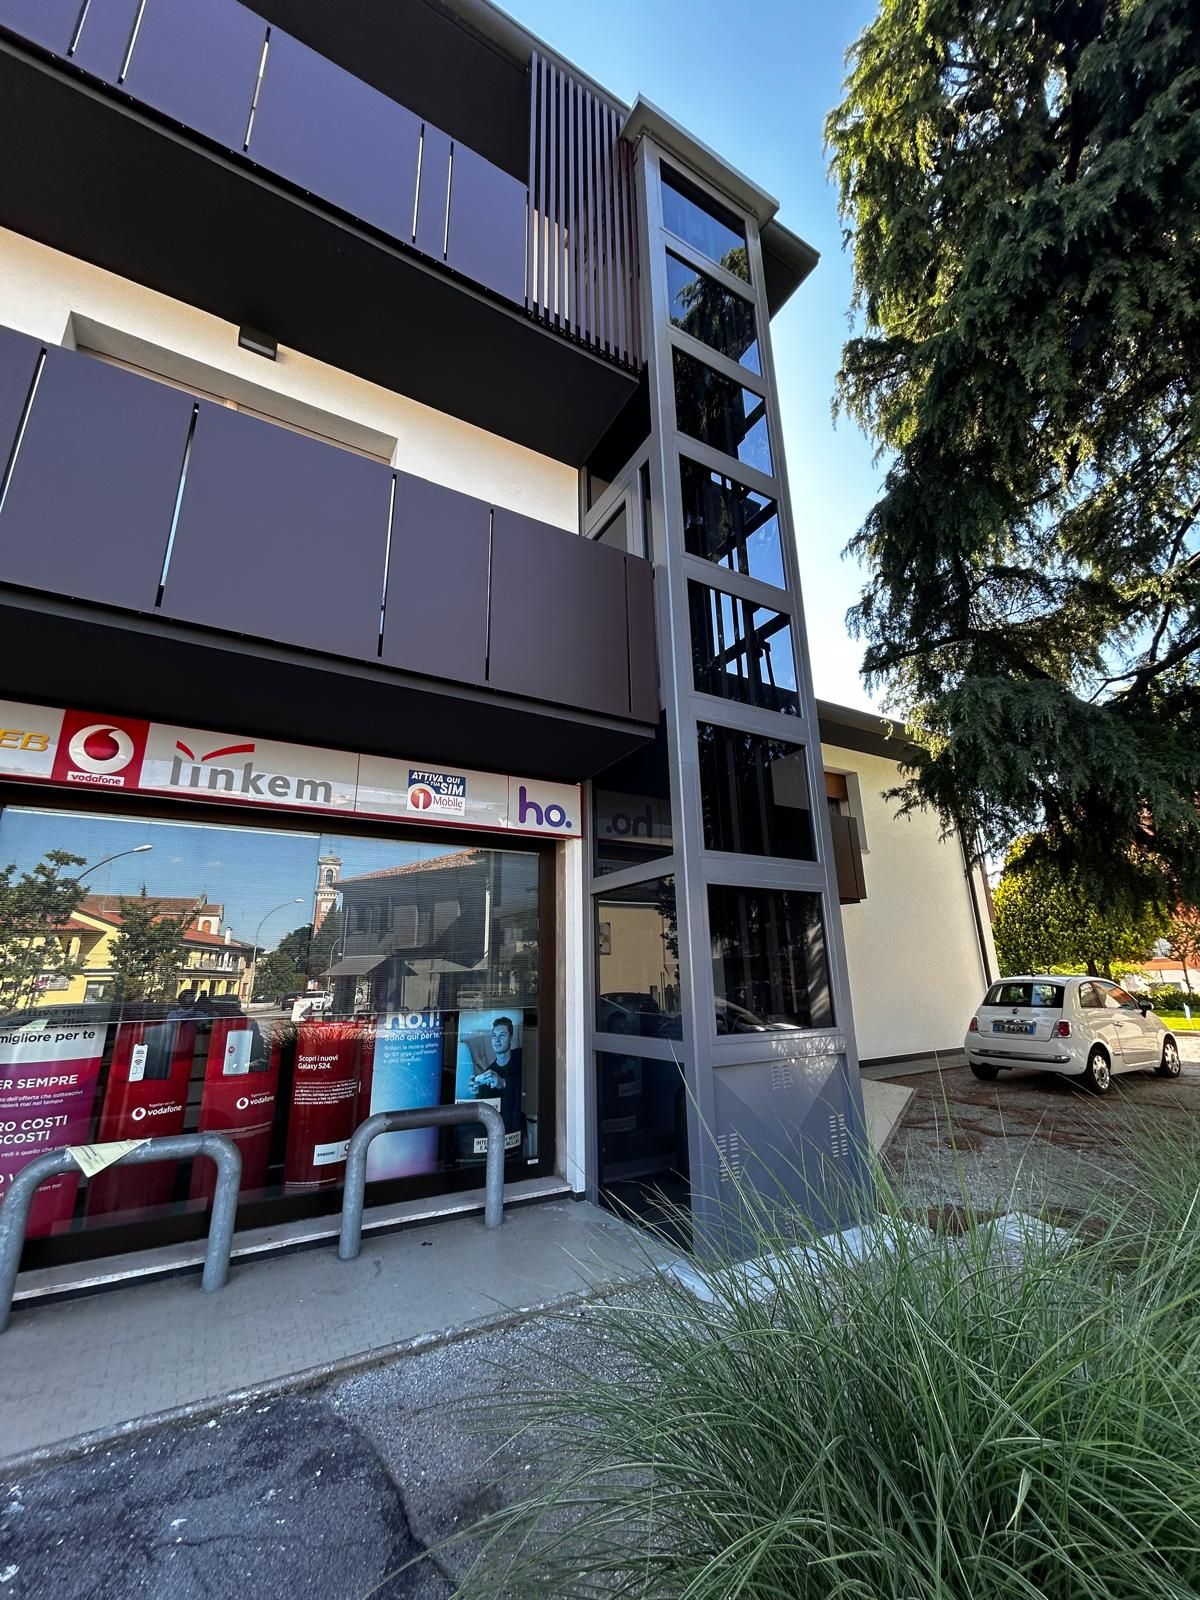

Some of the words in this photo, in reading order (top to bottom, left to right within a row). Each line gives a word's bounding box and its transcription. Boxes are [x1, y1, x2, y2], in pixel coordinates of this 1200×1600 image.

[71, 773, 122, 786] vodafone
[170, 755, 332, 802] linkem
[411, 771, 444, 783] ATTIVA
[446, 776, 461, 784] QUI
[440, 782, 464, 796] SIM
[519, 785, 572, 829] ho.
[0, 1033, 52, 1045] migliore
[55, 1032, 80, 1043] per
[82, 1030, 96, 1039] te
[298, 1055, 317, 1063] Scopri
[320, 1054, 339, 1062] nuovi
[297, 1062, 318, 1071] Galaxy
[17, 1074, 79, 1089] SEMPRE
[43, 1098, 64, 1106] tempo
[148, 1104, 183, 1117] vodafone
[21, 1115, 68, 1130] COSTI
